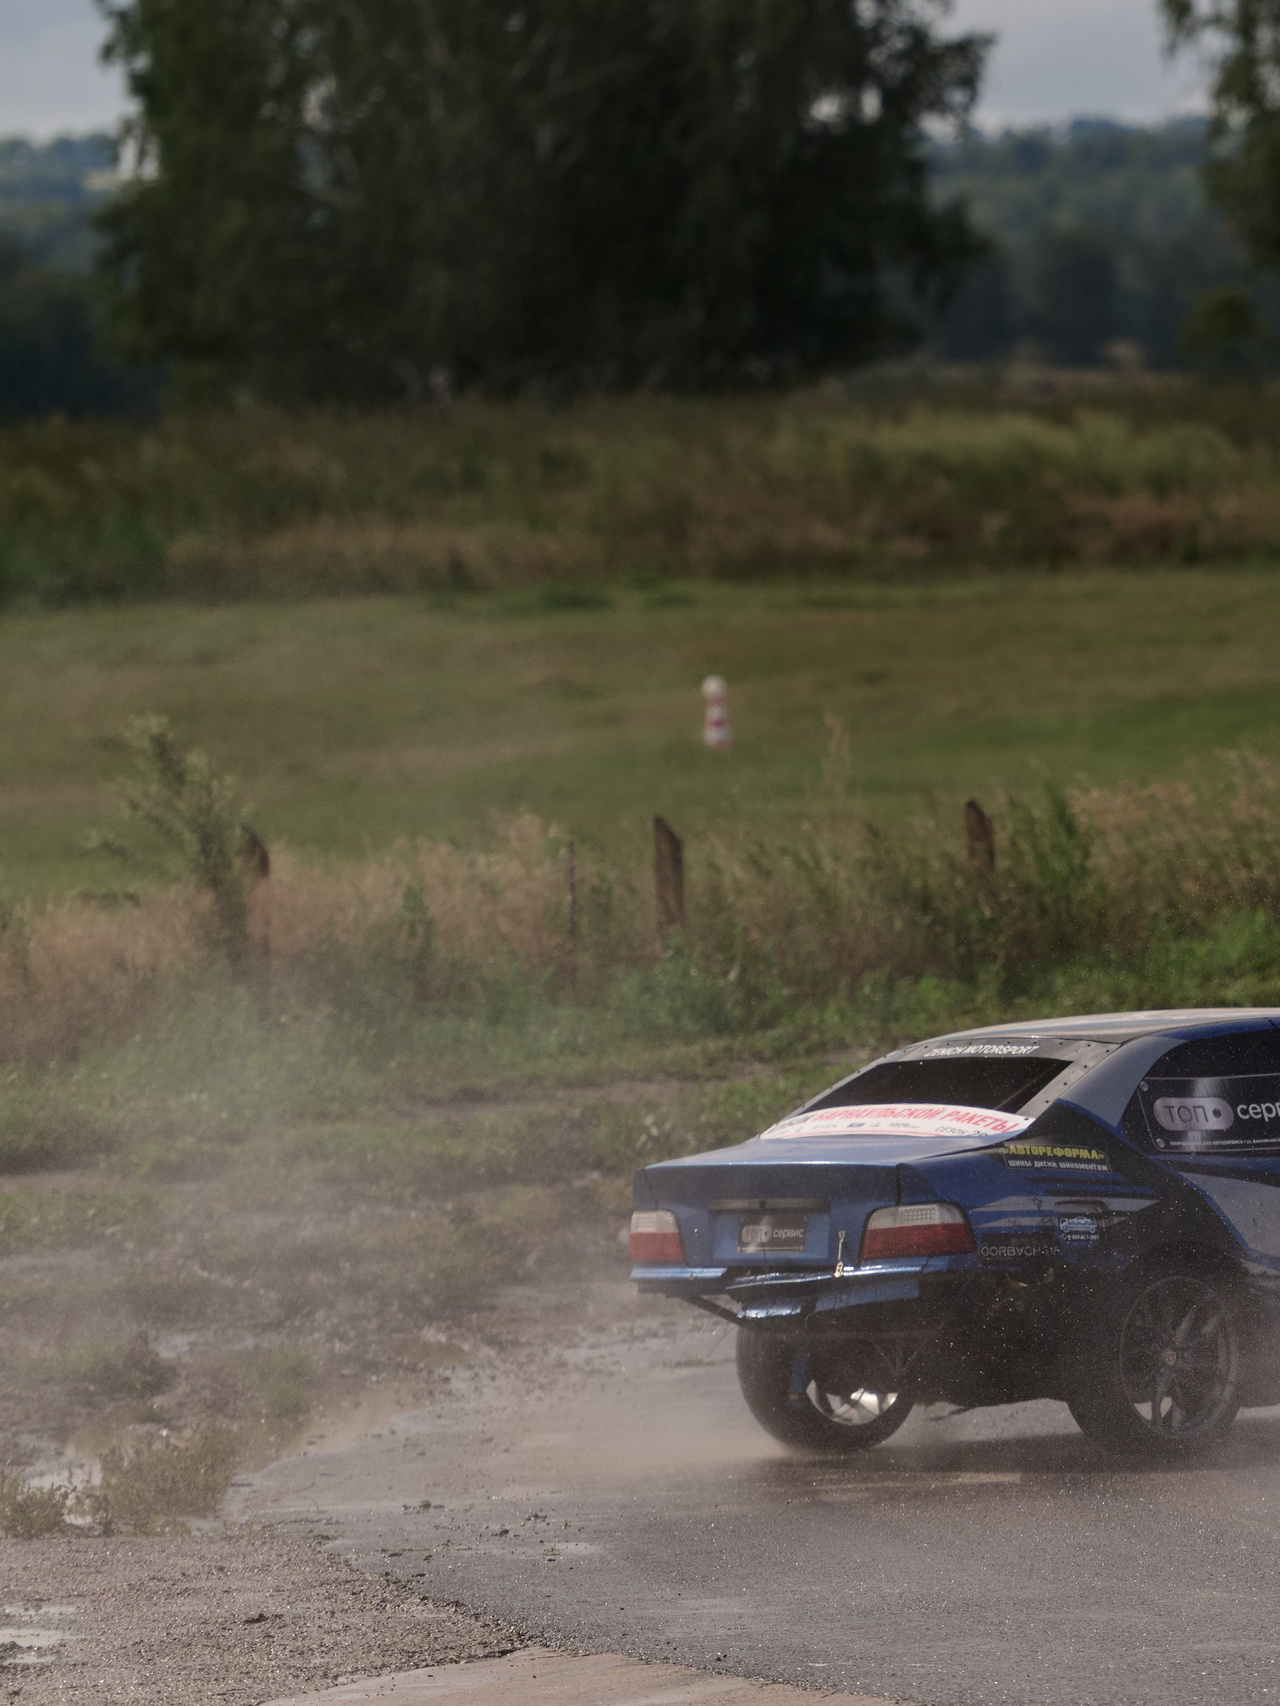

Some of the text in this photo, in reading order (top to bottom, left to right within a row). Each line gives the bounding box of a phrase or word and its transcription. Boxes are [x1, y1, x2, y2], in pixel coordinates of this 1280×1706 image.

[964, 1045, 1039, 1055] MOTORSPORT
[811, 1107, 946, 1122] БАРНАУЛЬСКОЙ
[940, 1111, 1019, 1132] РАКЕТЫ
[1163, 1105, 1209, 1123] ТОП
[772, 1228, 804, 1239] сервис
